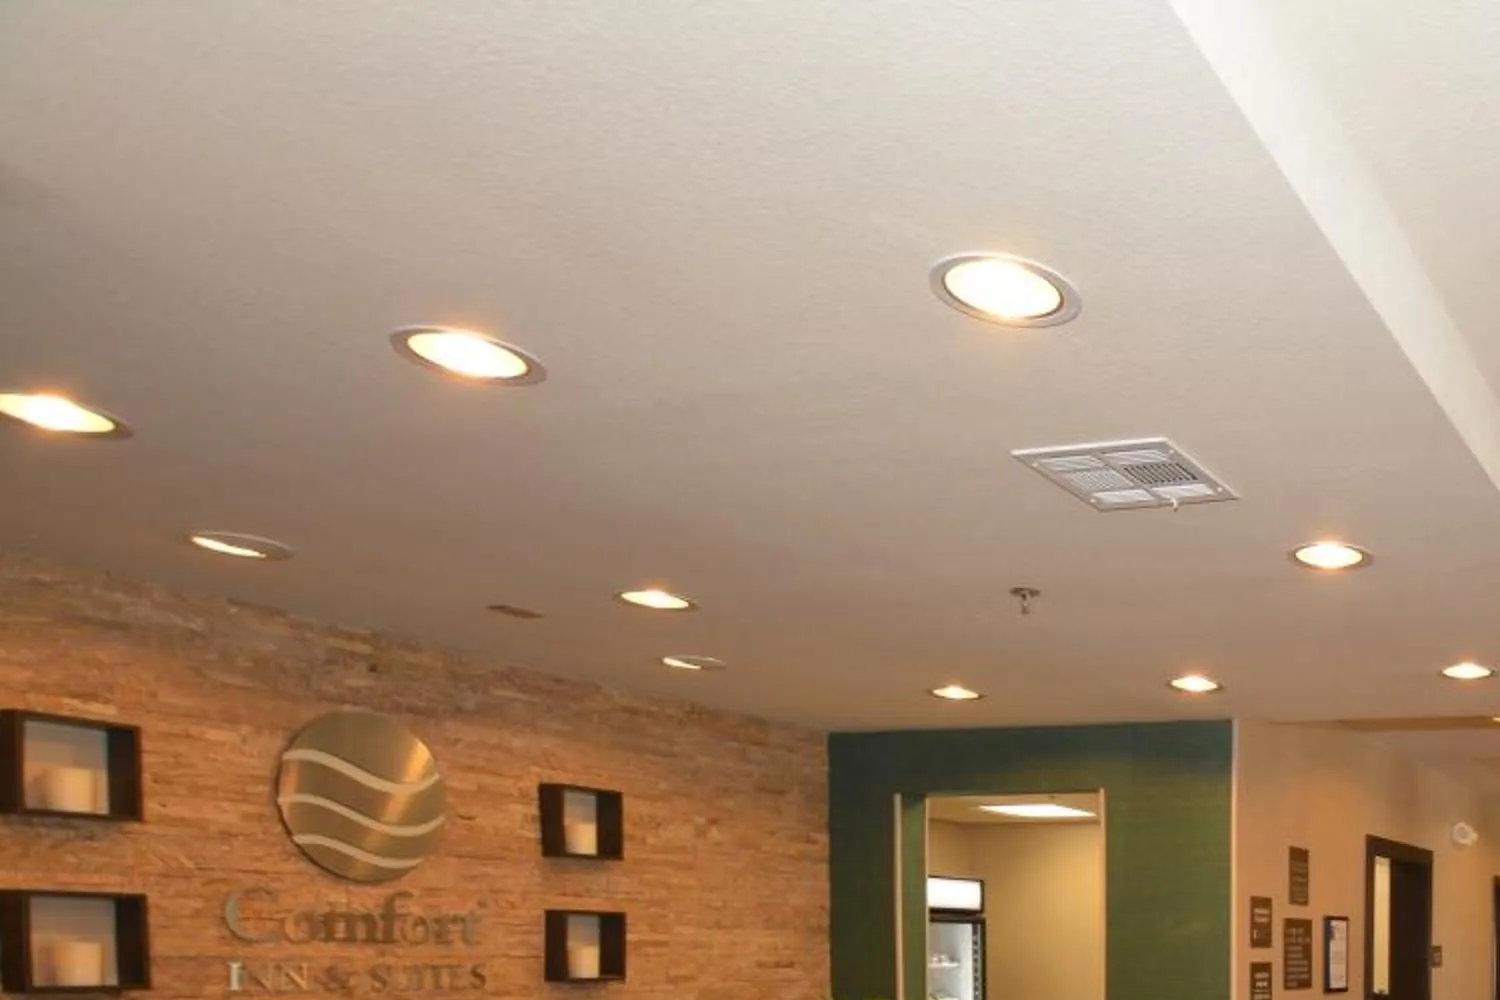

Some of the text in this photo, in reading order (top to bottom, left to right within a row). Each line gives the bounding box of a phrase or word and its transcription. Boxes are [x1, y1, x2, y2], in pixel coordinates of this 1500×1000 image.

[224, 887, 479, 946] Comfort
[227, 959, 487, 992] INN & SUITES
